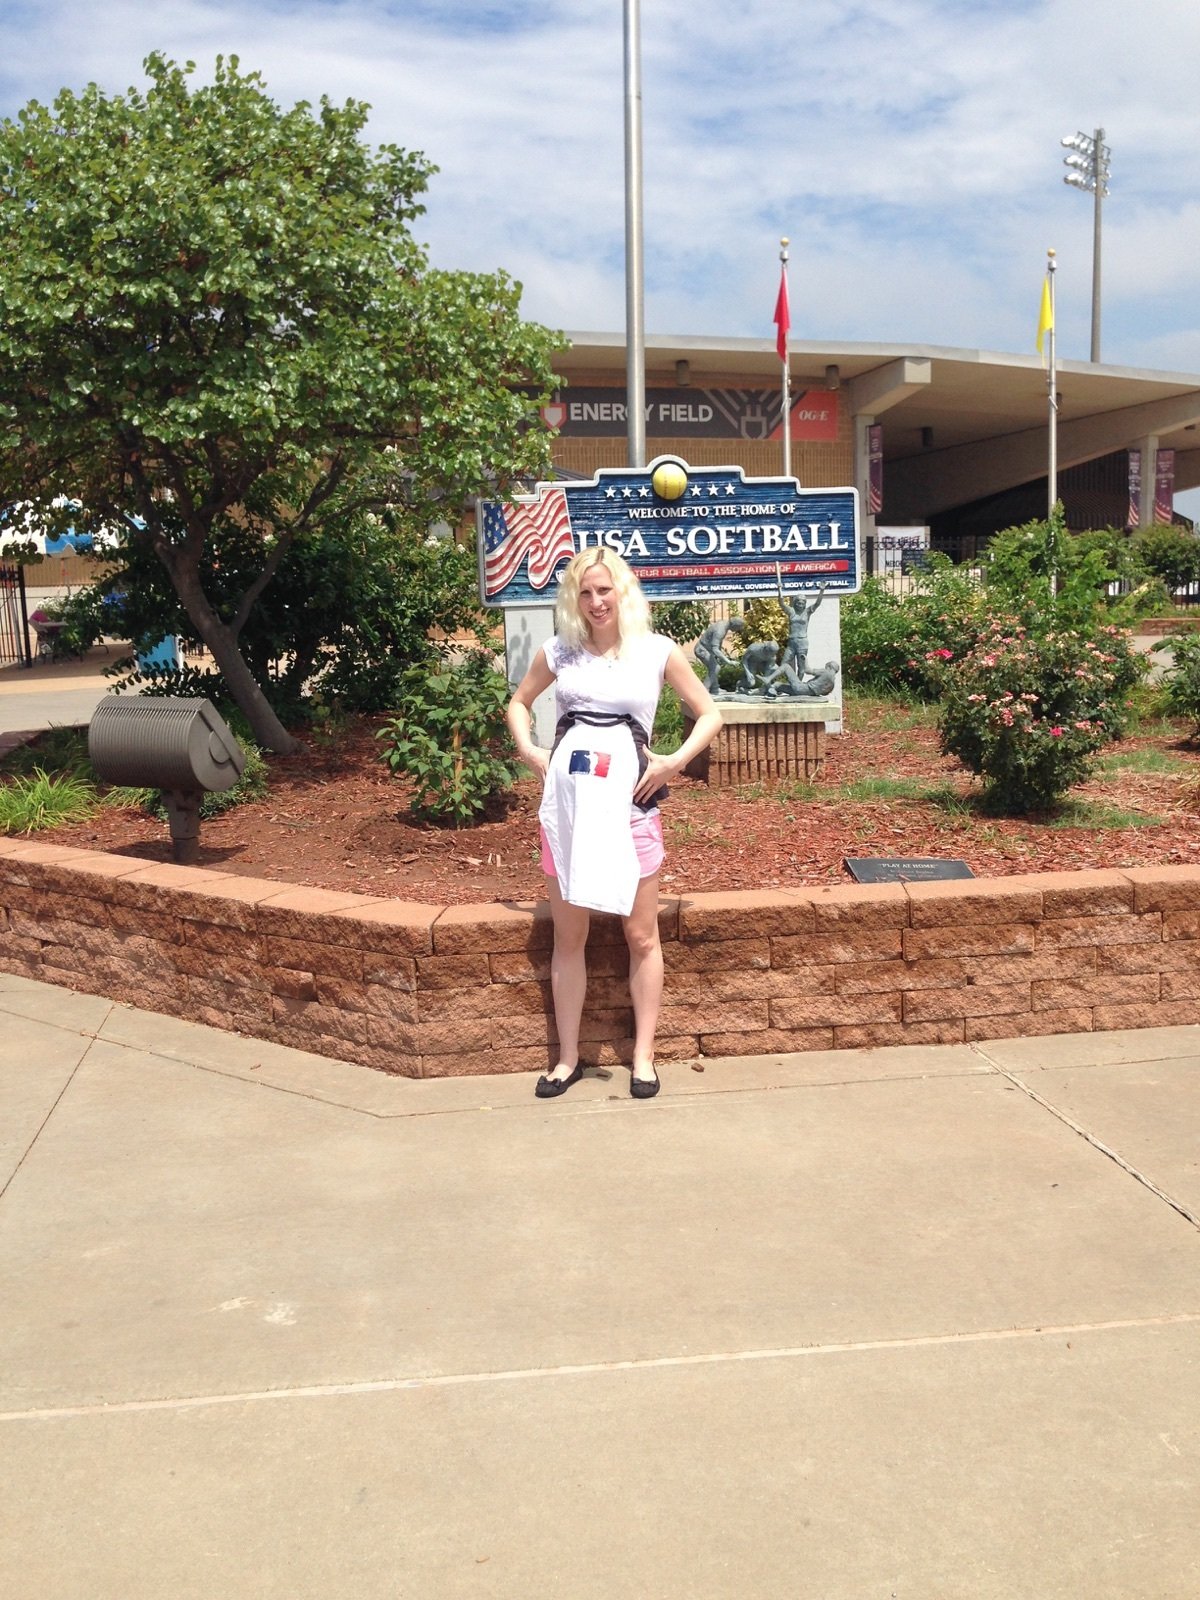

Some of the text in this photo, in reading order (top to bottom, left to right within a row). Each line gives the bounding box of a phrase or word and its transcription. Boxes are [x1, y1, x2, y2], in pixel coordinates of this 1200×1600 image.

[569, 402, 713, 423] ENERY FIELD
[628, 503, 796, 519] WELCOME TO THE HOME OF
[576, 529, 651, 557] USA
[667, 523, 849, 556] SOFTBALL
[662, 567, 711, 577] SOFTBALL
[713, 564, 776, 576] ASSOCIATION
[779, 563, 792, 573] OF
[794, 562, 837, 573] AMERICA
[710, 583, 744, 591] NATIONAL
[745, 582, 778, 590] GOVERNIN
[784, 580, 803, 588] BODY
